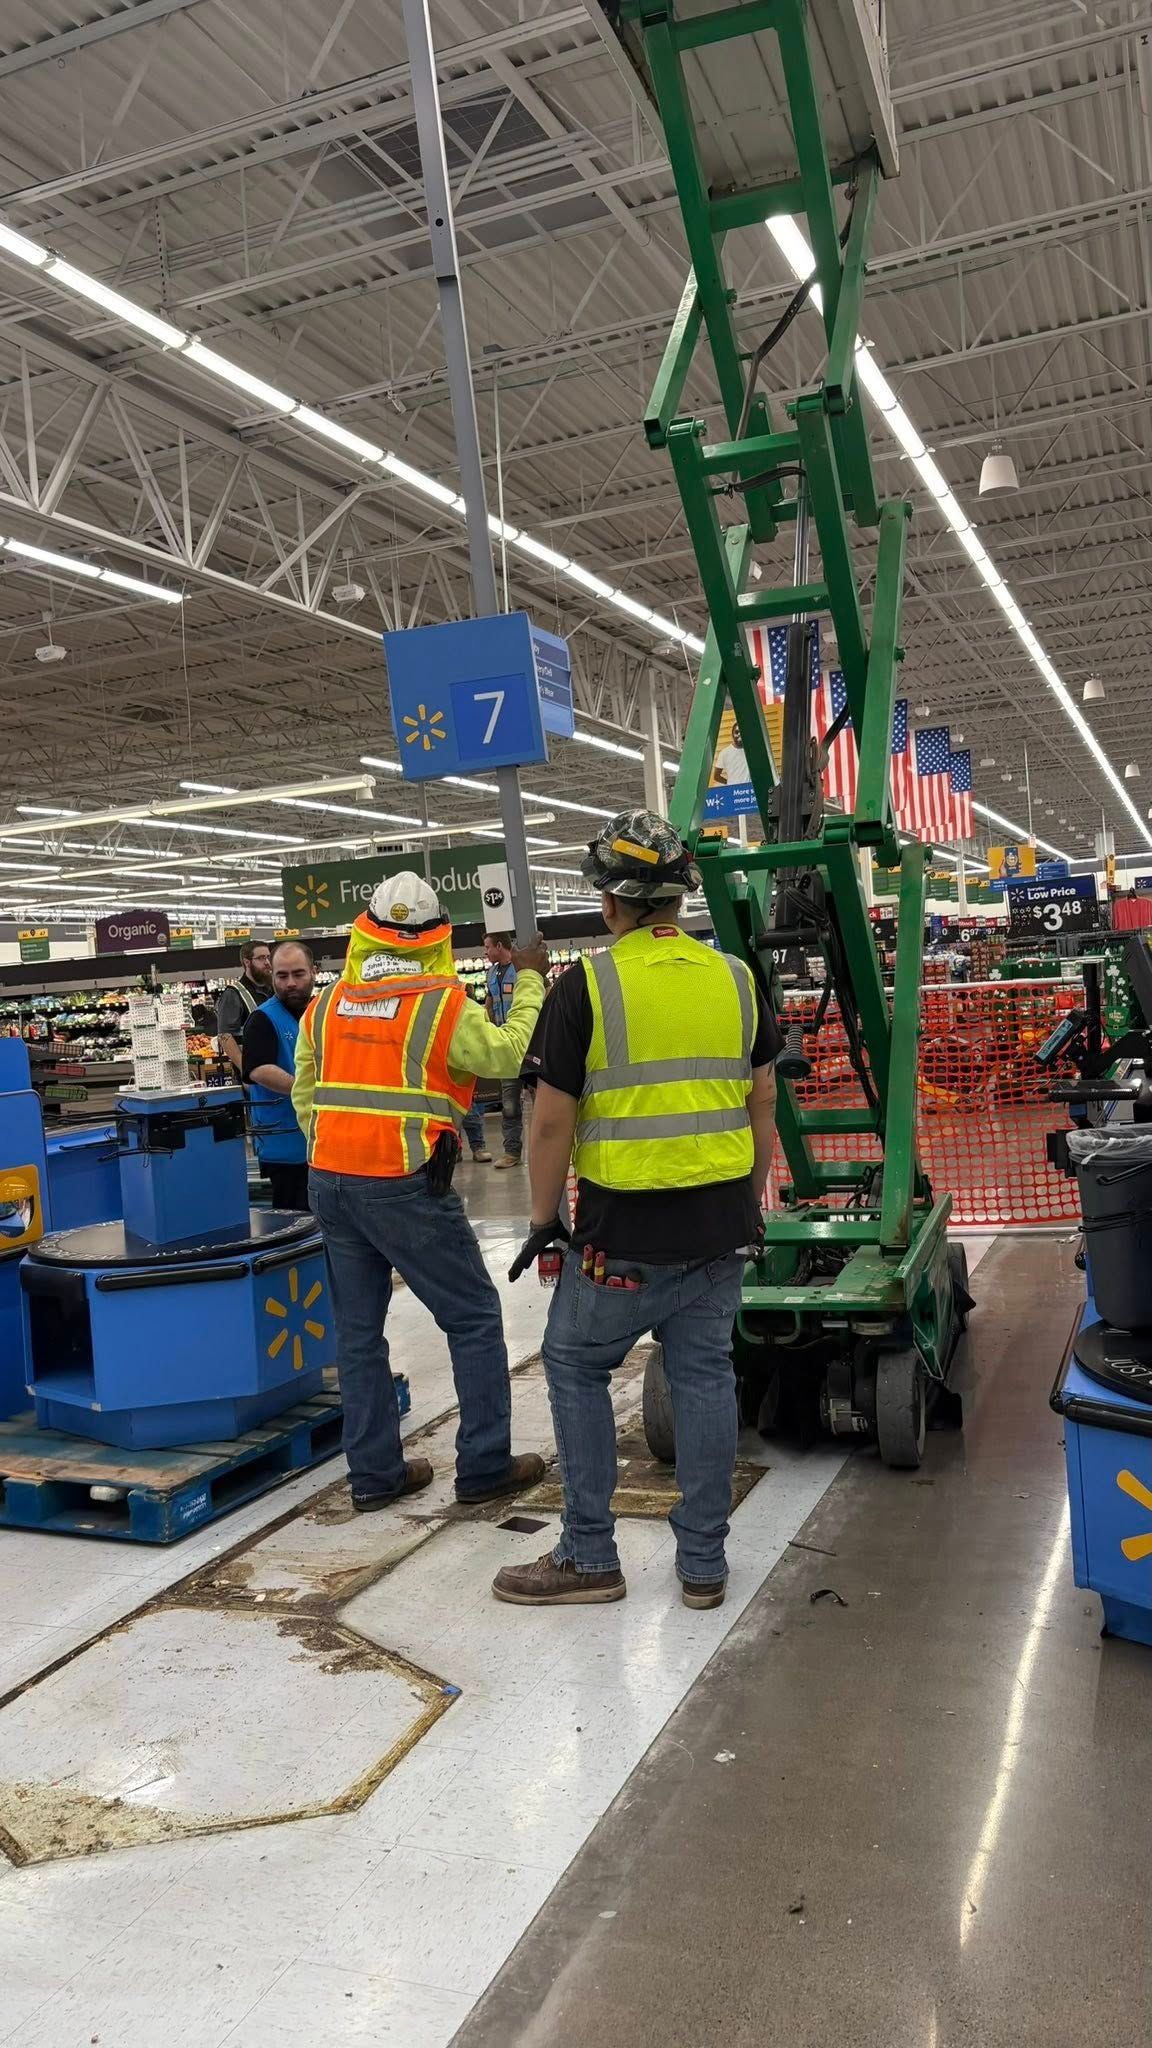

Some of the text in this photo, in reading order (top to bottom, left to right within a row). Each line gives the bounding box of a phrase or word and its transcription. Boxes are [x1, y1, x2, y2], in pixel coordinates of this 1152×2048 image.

[474, 690, 505, 744] 7
[1027, 886, 1077, 901] Low Price
[107, 920, 157, 941] Organic
